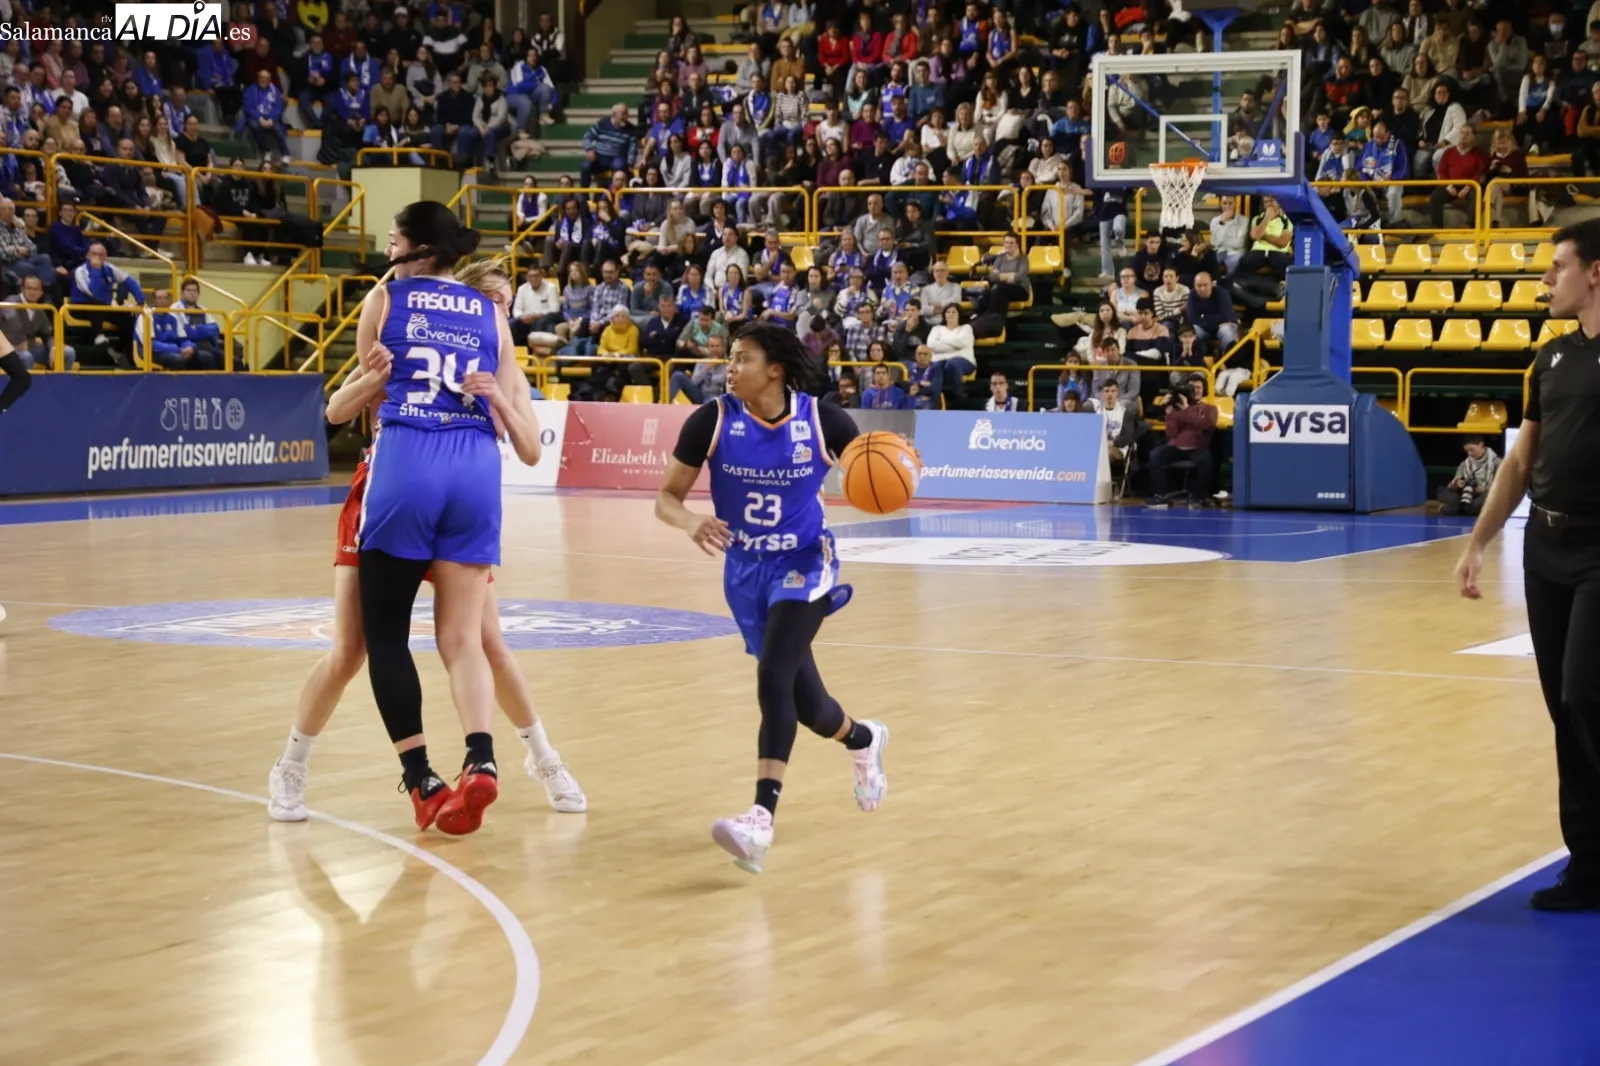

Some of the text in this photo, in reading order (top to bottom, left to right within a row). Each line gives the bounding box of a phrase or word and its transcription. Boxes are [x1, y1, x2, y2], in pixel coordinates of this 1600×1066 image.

[407, 291, 483, 316] FASOULA
[405, 346, 480, 406] 34
[87, 434, 315, 480] perfumeriasavenida.com
[590, 448, 653, 466] Elizabeth
[722, 462, 814, 479] CASTILLA Y LEÓN
[920, 464, 1086, 483] perfumeriasavenida.com
[744, 492, 782, 527] 23
